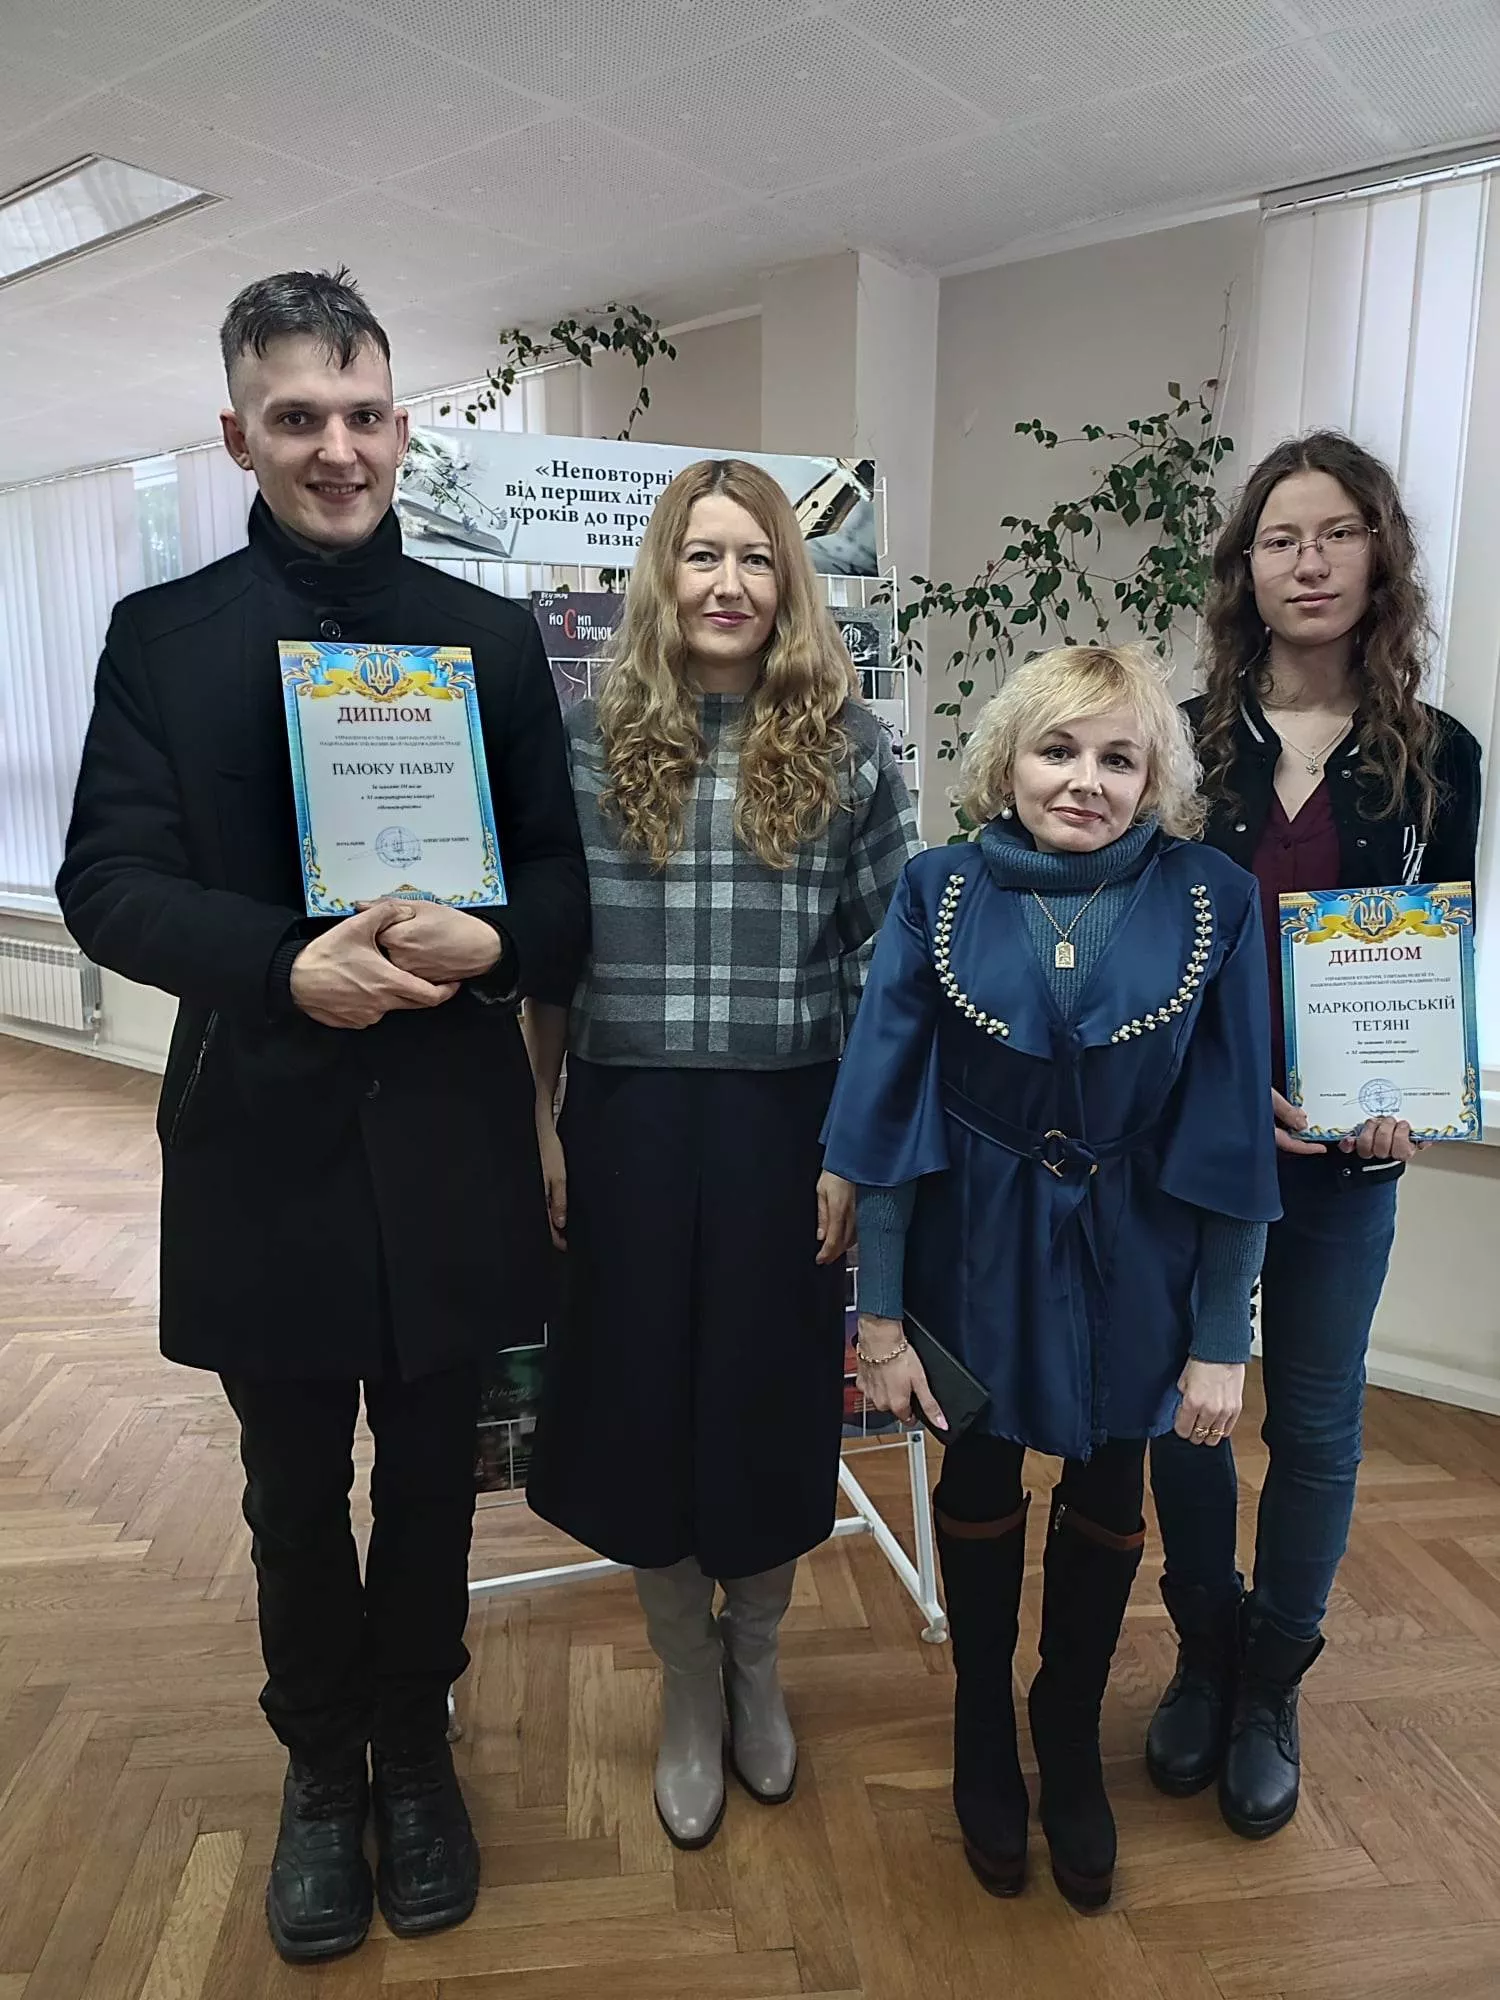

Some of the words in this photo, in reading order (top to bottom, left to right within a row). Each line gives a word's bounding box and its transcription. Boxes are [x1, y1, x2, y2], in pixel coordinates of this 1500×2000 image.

[505, 480, 536, 501] від
[541, 486, 622, 506] перших
[509, 505, 579, 526] кроків
[584, 511, 608, 527] до
[337, 706, 433, 725] ДИПЛОМ
[332, 763, 395, 775] ПАЮКУ
[400, 762, 455, 775] ПАВЛУ
[1328, 946, 1422, 967] ДИПЛОМ
[1308, 995, 1456, 1014] МАРКОПОЛЬСЬКІЙ
[1352, 1019, 1410, 1032] ТЕТЯНІ
